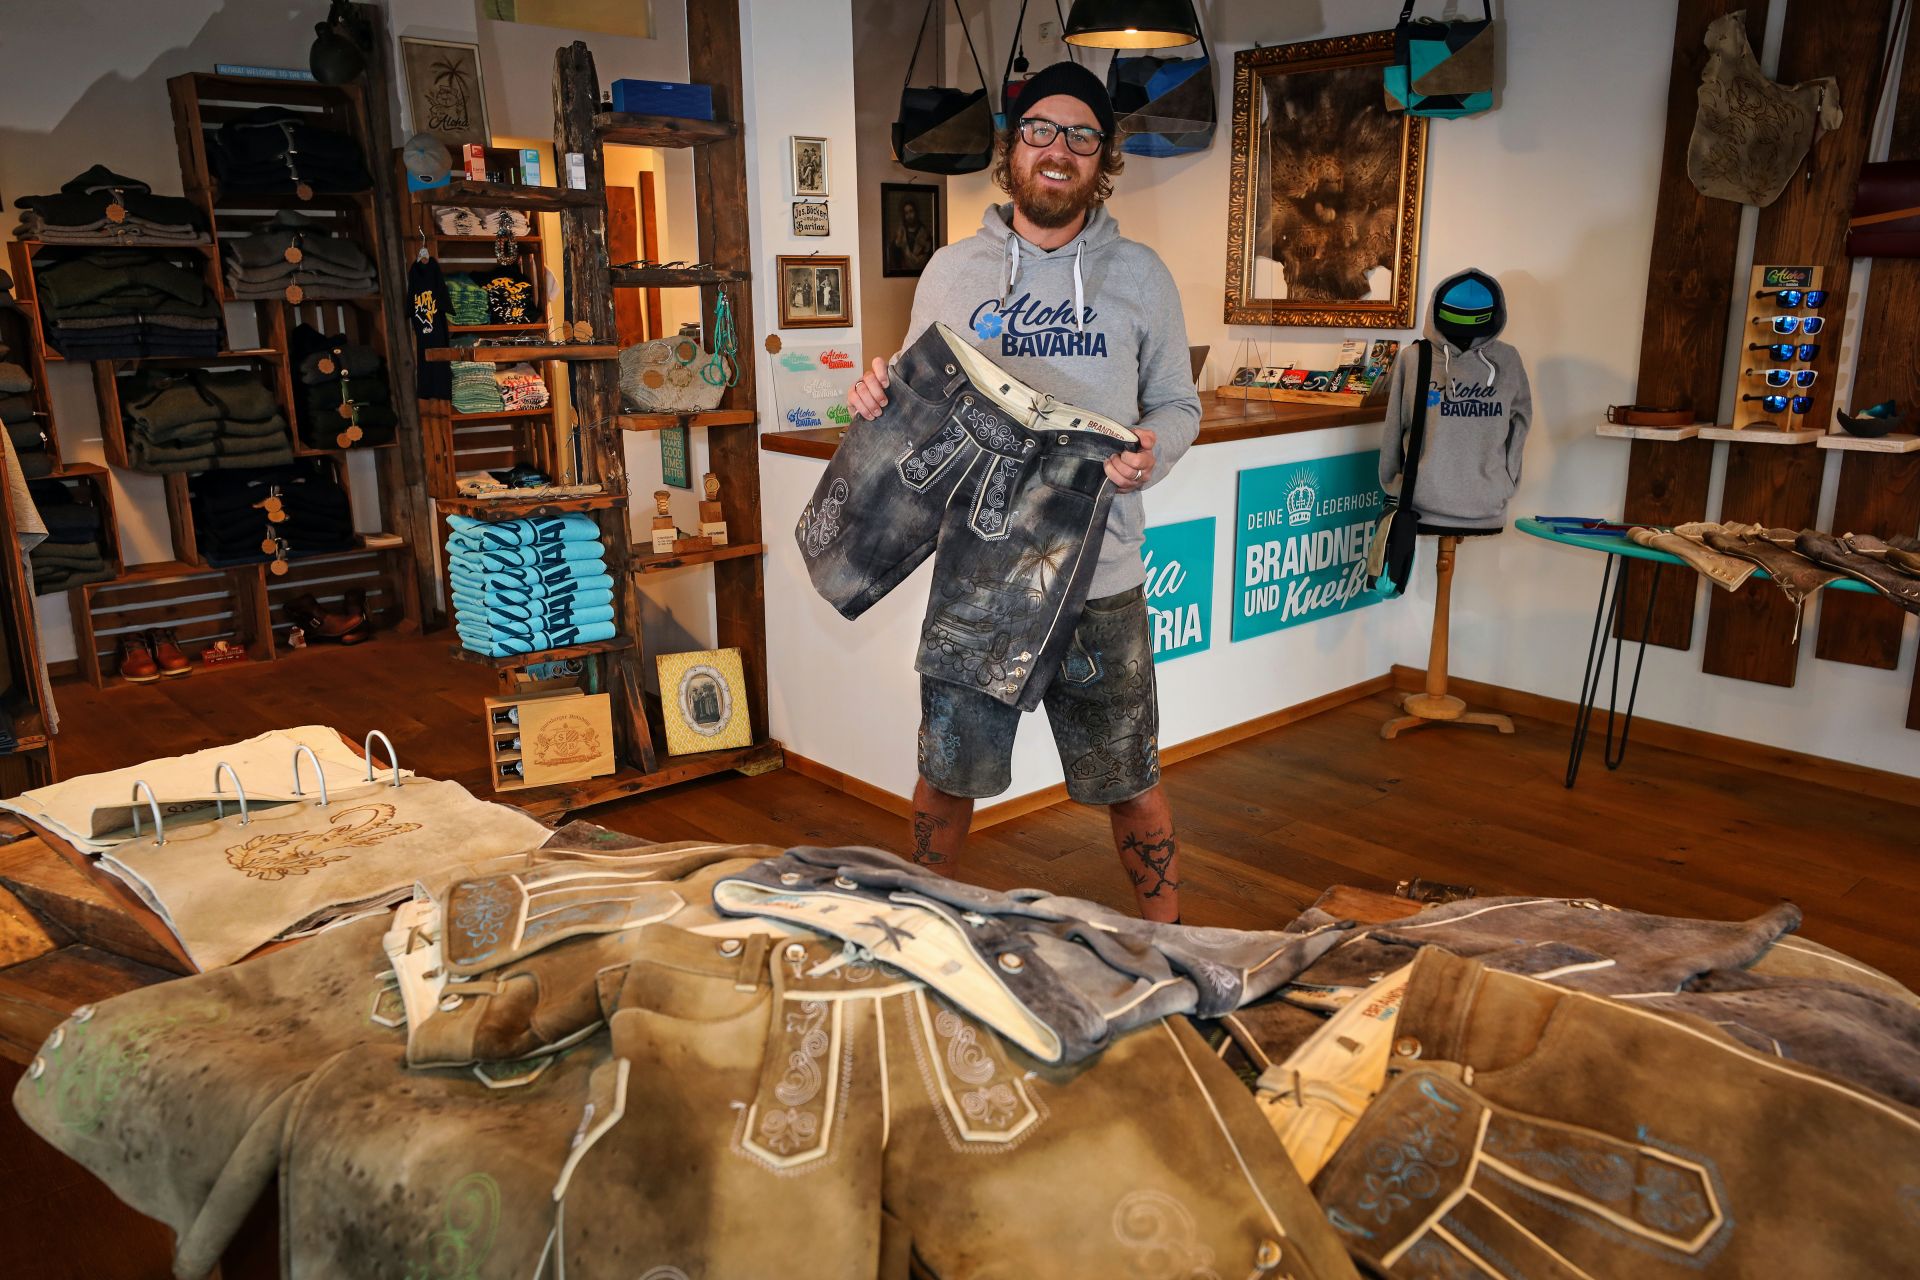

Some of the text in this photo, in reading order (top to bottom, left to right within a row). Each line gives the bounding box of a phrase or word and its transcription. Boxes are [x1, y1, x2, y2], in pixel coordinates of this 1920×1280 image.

[428, 114, 469, 131] Aloha
[1767, 267, 1806, 283] Aloha
[969, 293, 1097, 337] Aloha
[1001, 332, 1108, 358] BAVARIA
[820, 350, 849, 362] Aloha
[787, 407, 817, 422] Aloha
[1440, 401, 1503, 417] BAVARIA
[662, 439, 683, 448] MAKE
[663, 446, 683, 458] GOOD
[664, 456, 683, 469] TIMES
[664, 467, 684, 478] BETTER
[1247, 490, 1381, 531] DEINE LEDERHOSE.
[1244, 586, 1280, 617] UND
